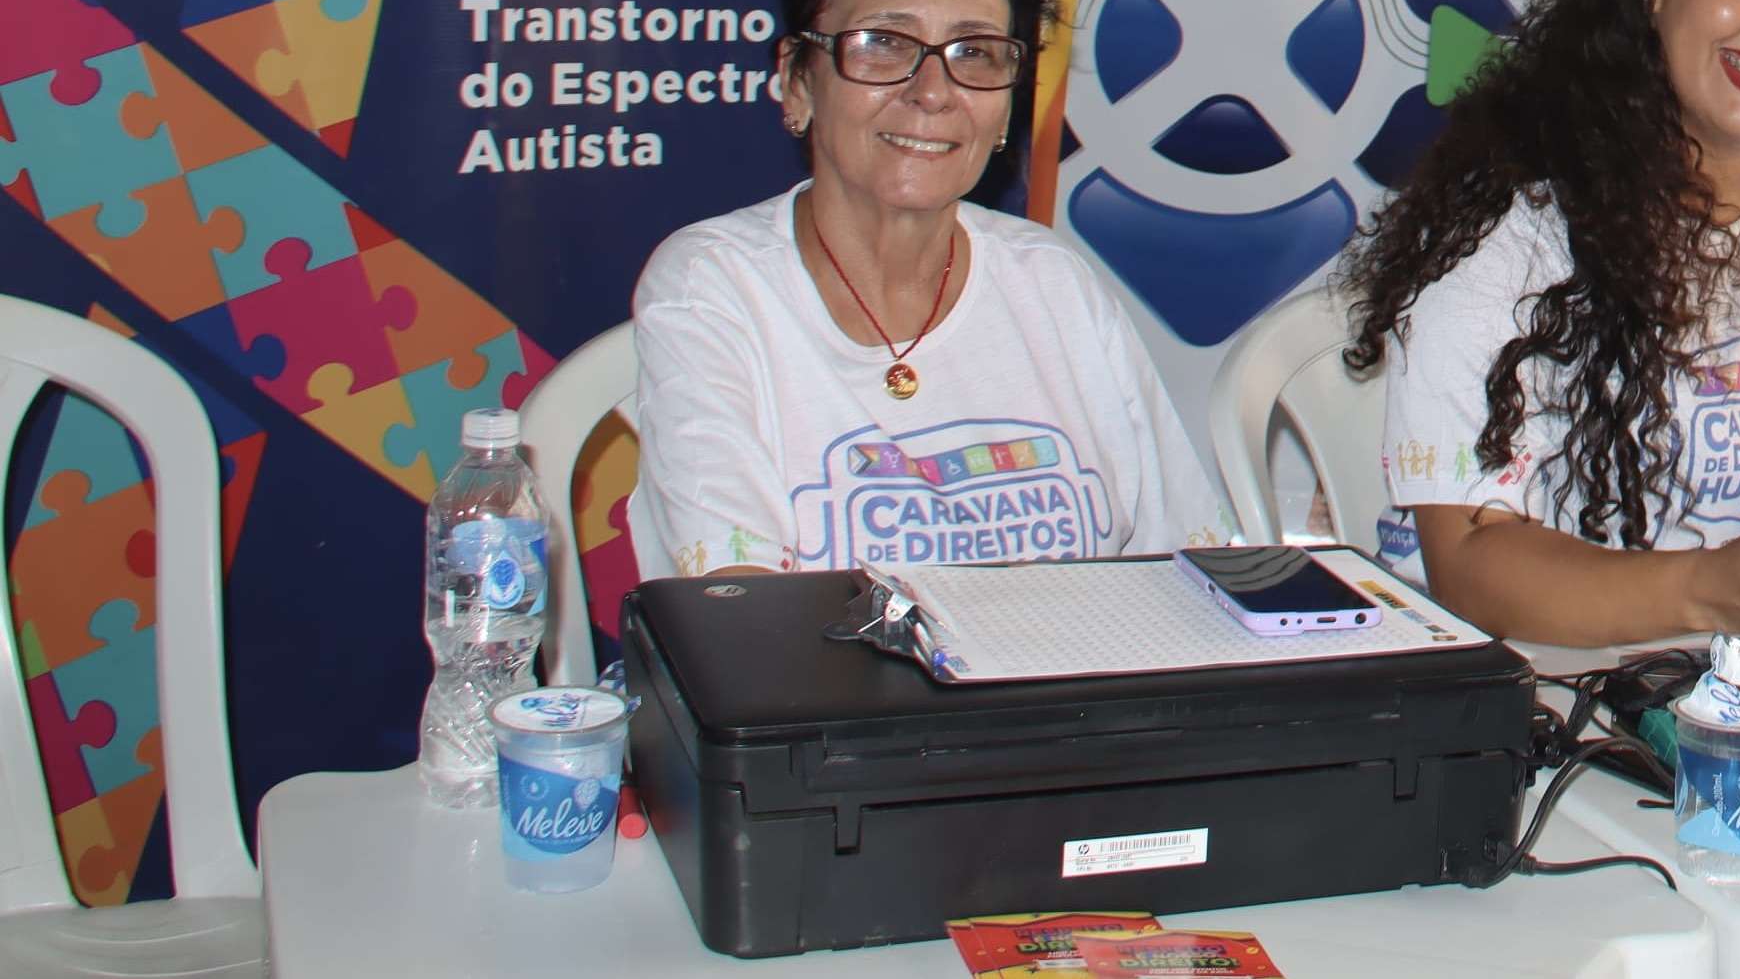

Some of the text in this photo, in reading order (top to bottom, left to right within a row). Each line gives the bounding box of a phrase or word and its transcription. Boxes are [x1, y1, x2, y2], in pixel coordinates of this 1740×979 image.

[460, 62, 533, 109] do
[458, 124, 664, 174] Autista
[1704, 456, 1729, 473] DE
[861, 484, 1071, 539] CARAVANA
[867, 516, 1077, 563] DE DIREITOS
